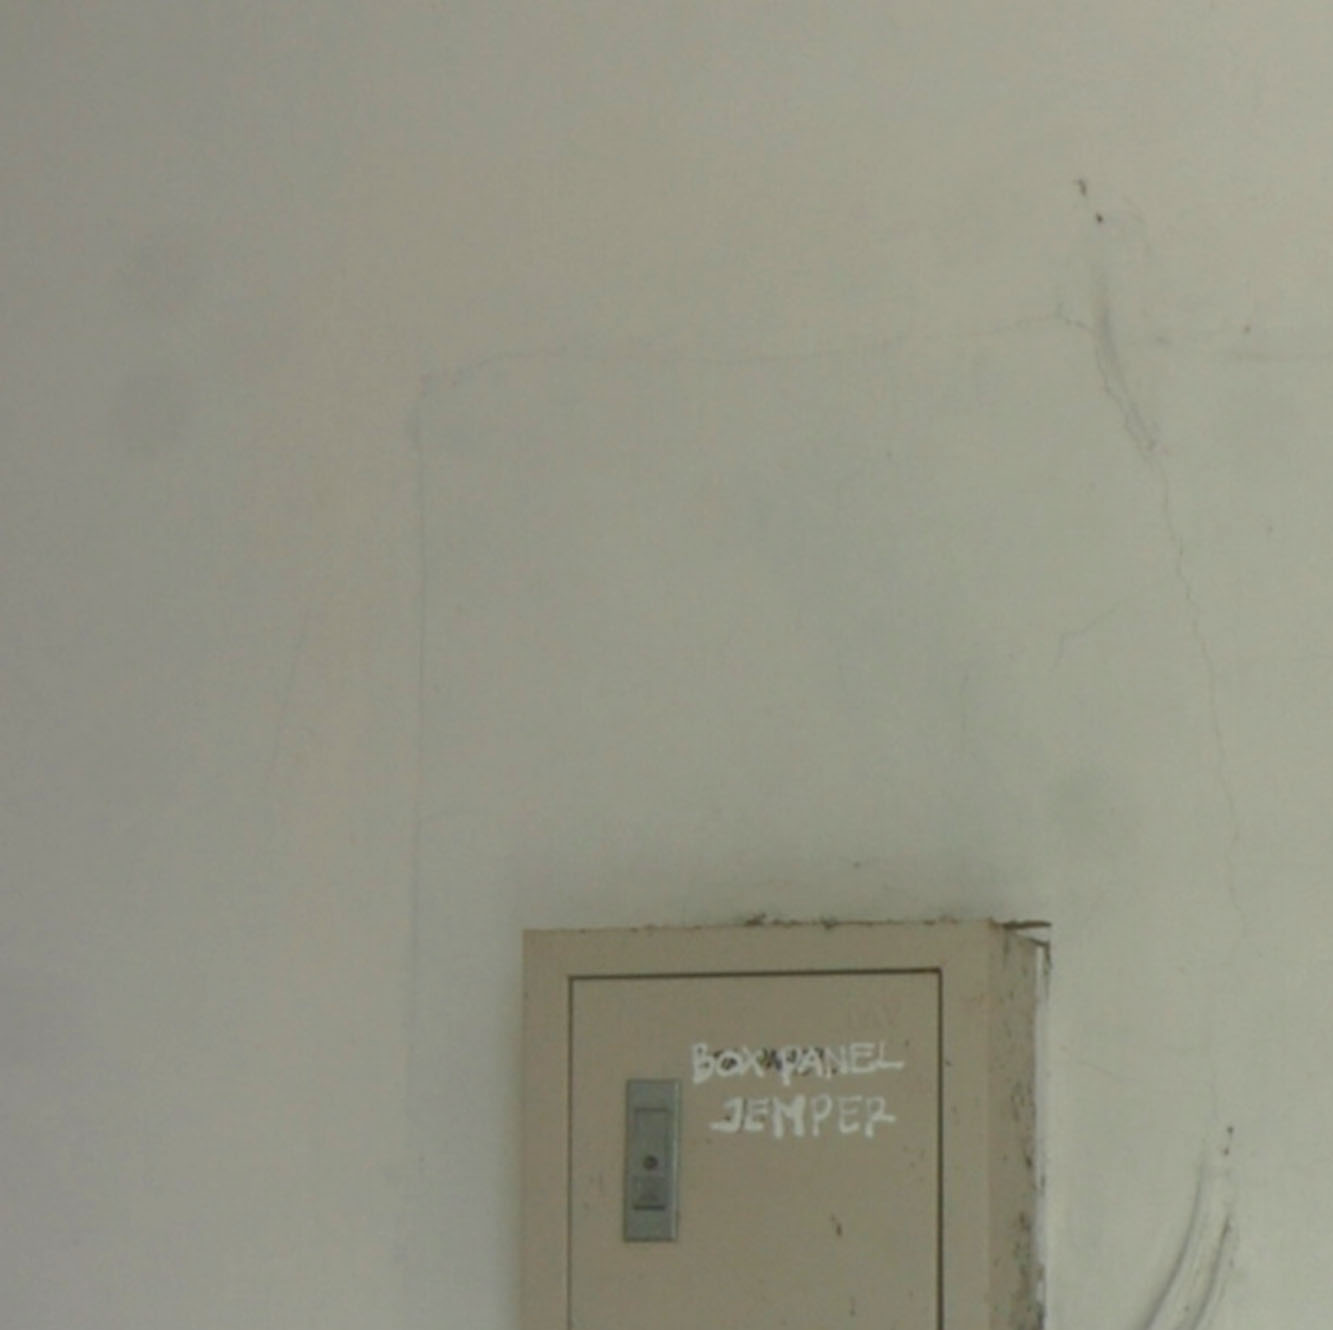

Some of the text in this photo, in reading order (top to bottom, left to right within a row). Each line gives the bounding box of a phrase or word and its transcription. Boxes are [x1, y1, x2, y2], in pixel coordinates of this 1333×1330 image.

[692, 1040, 905, 1087] BOX PANEL
[709, 1093, 897, 1140] JEMPER
